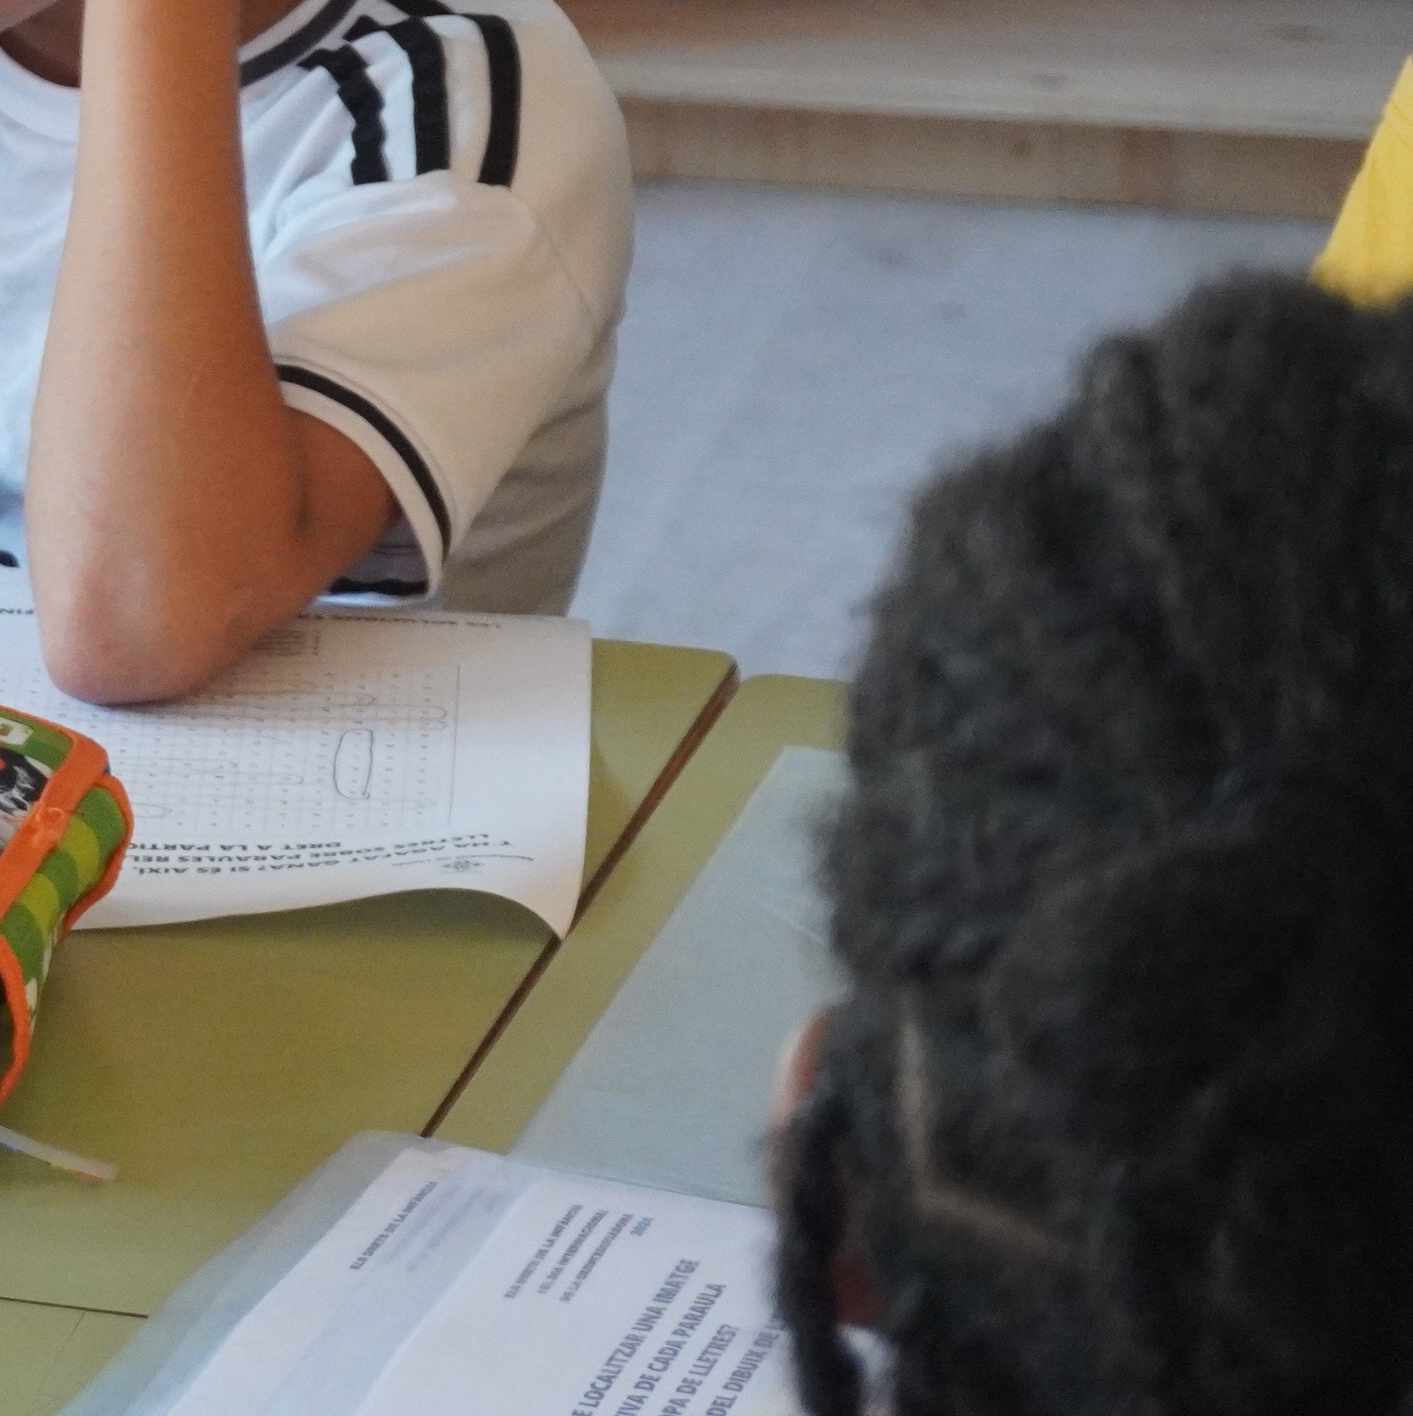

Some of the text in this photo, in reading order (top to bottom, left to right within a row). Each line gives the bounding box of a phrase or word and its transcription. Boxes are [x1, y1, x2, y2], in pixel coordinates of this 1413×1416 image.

[178, 855, 302, 863] PARAULES
[671, 1283, 727, 1338] PARAULA
[578, 1333, 646, 1408] LOCALITZAR
[631, 1305, 668, 1333] UNA
[652, 1258, 700, 1304] IMATGE
[647, 1339, 688, 1373] CADA
[722, 1348, 768, 1393] DIBUIX
[633, 1373, 662, 1392] DE
[675, 1377, 704, 1396] DE
